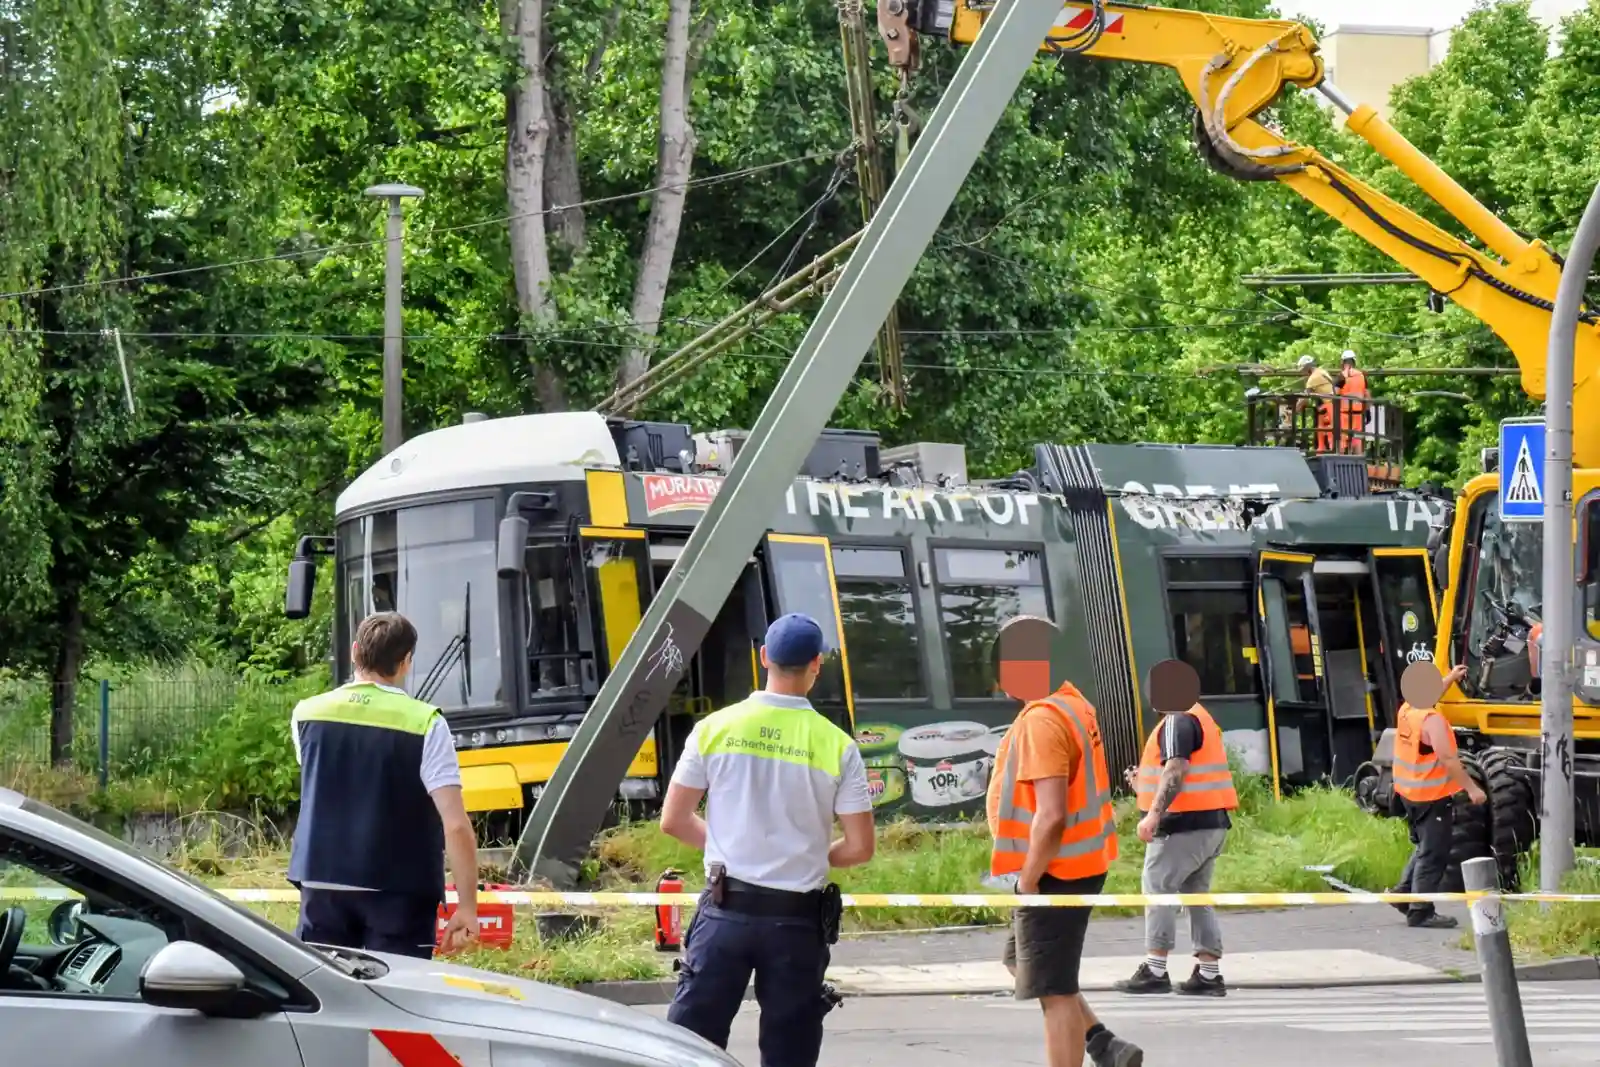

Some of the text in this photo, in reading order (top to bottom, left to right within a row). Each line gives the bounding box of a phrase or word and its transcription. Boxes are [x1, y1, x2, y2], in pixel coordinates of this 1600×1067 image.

[980, 493, 1039, 525] OF
[760, 726, 781, 740] BVG
[928, 773, 959, 790] TOPi
